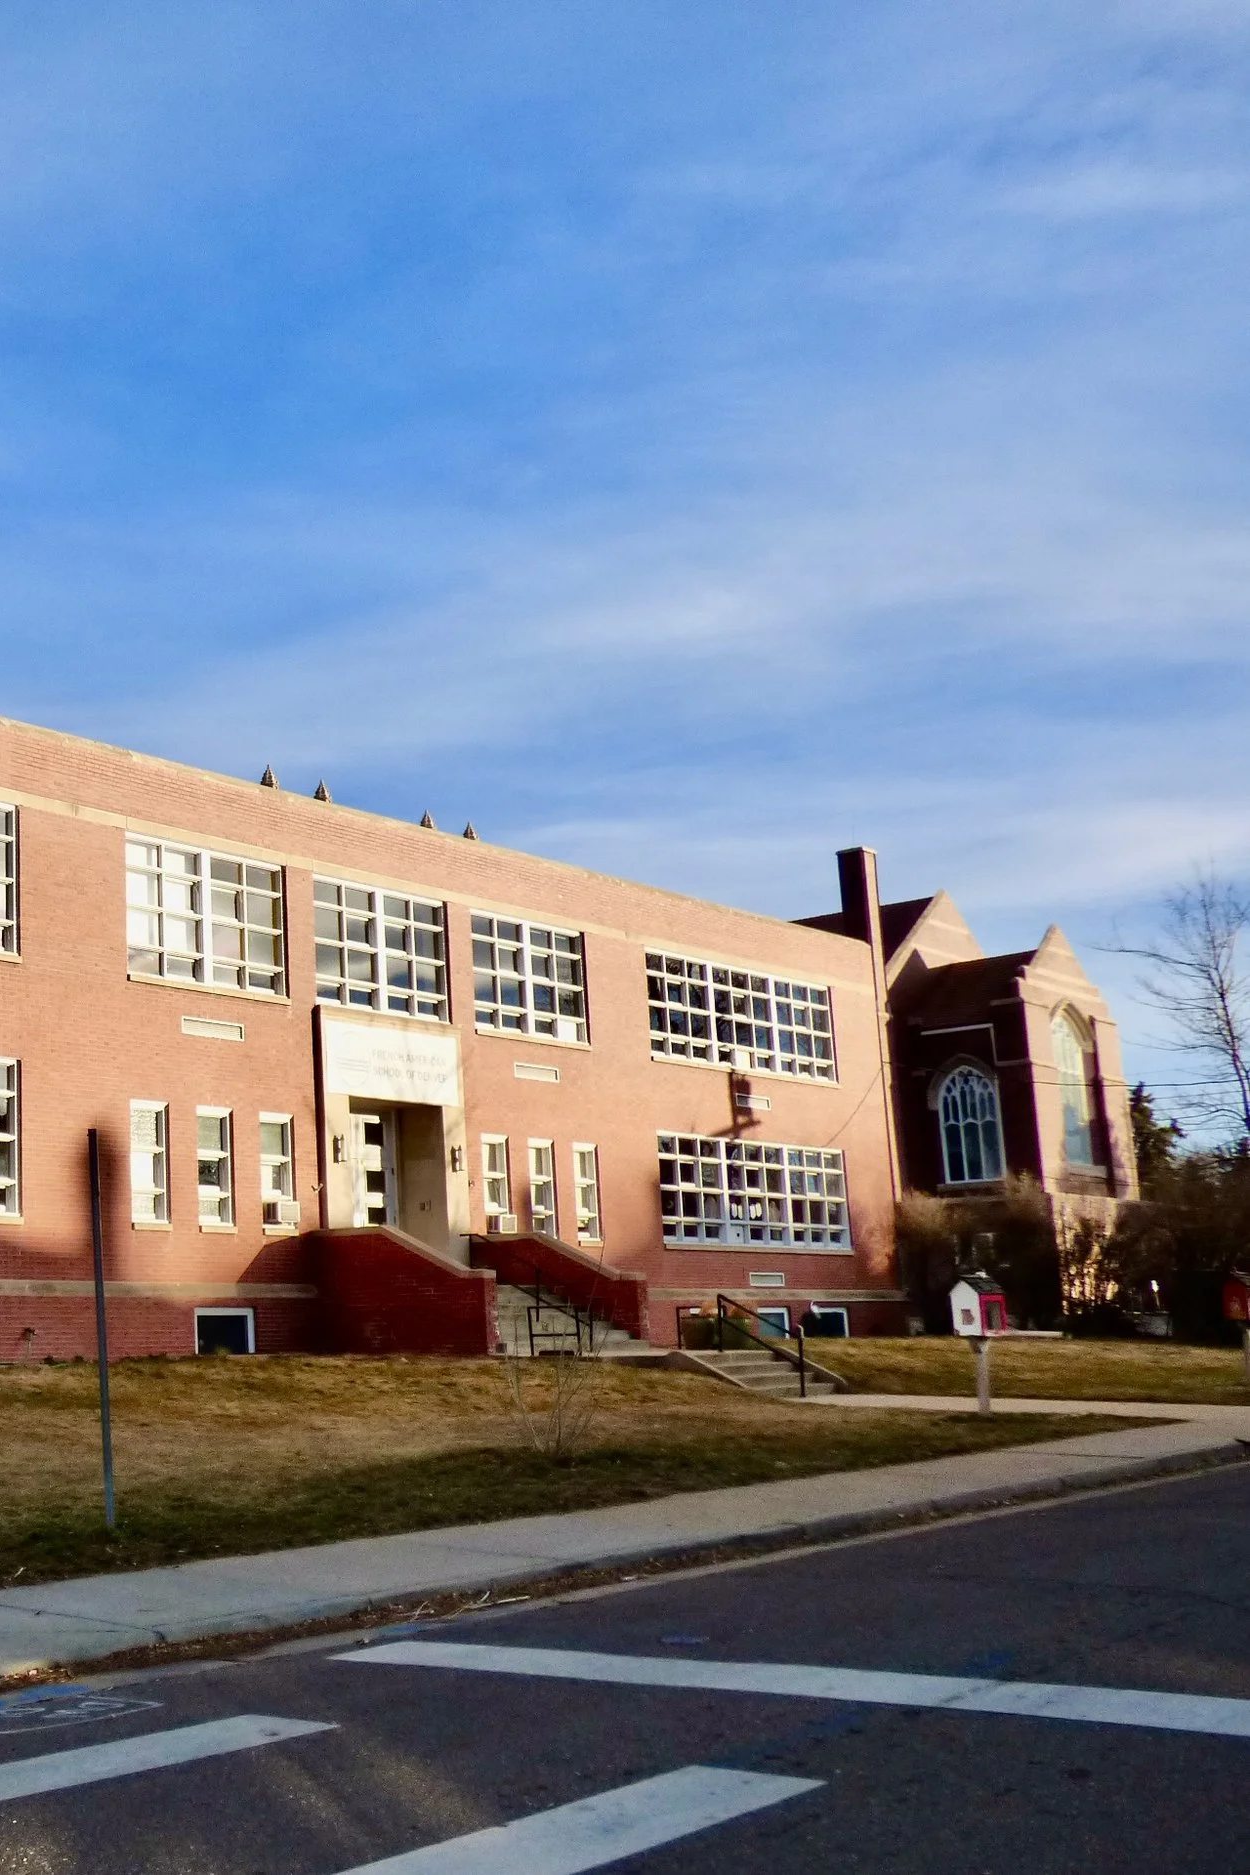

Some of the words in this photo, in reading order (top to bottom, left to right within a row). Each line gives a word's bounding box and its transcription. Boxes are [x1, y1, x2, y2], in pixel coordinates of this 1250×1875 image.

[371, 1048, 404, 1063] FRENCH
[405, 1053, 447, 1067] AMERICAN
[372, 1066, 404, 1080] SCHOOL
[407, 1069, 417, 1081] OF
[417, 1070, 449, 1084] DENVER
